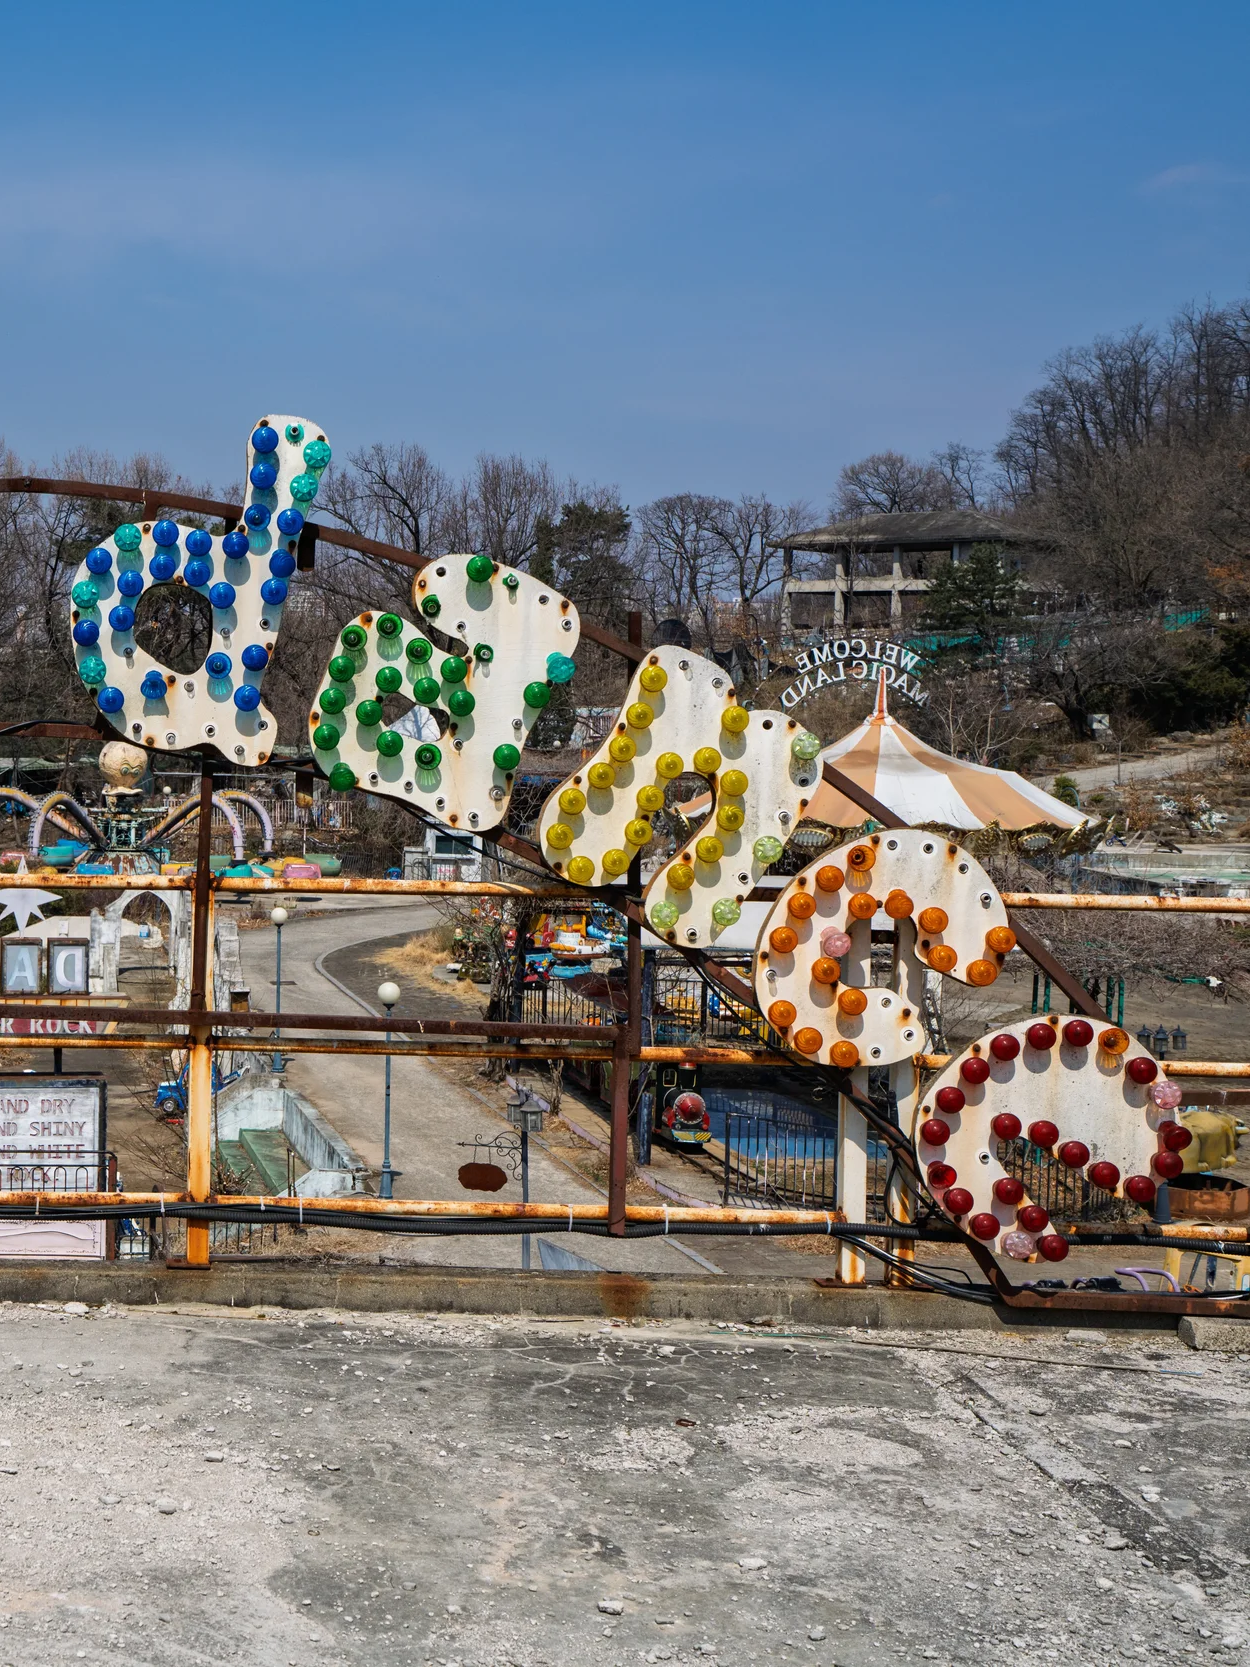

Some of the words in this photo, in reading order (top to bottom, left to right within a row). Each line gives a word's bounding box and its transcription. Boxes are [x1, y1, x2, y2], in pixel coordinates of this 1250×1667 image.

[30, 1018, 96, 1035] ROCK
[40, 1098, 76, 1115] DRY
[29, 1121, 86, 1137] SHINY
[29, 1143, 86, 1159] WHITE
